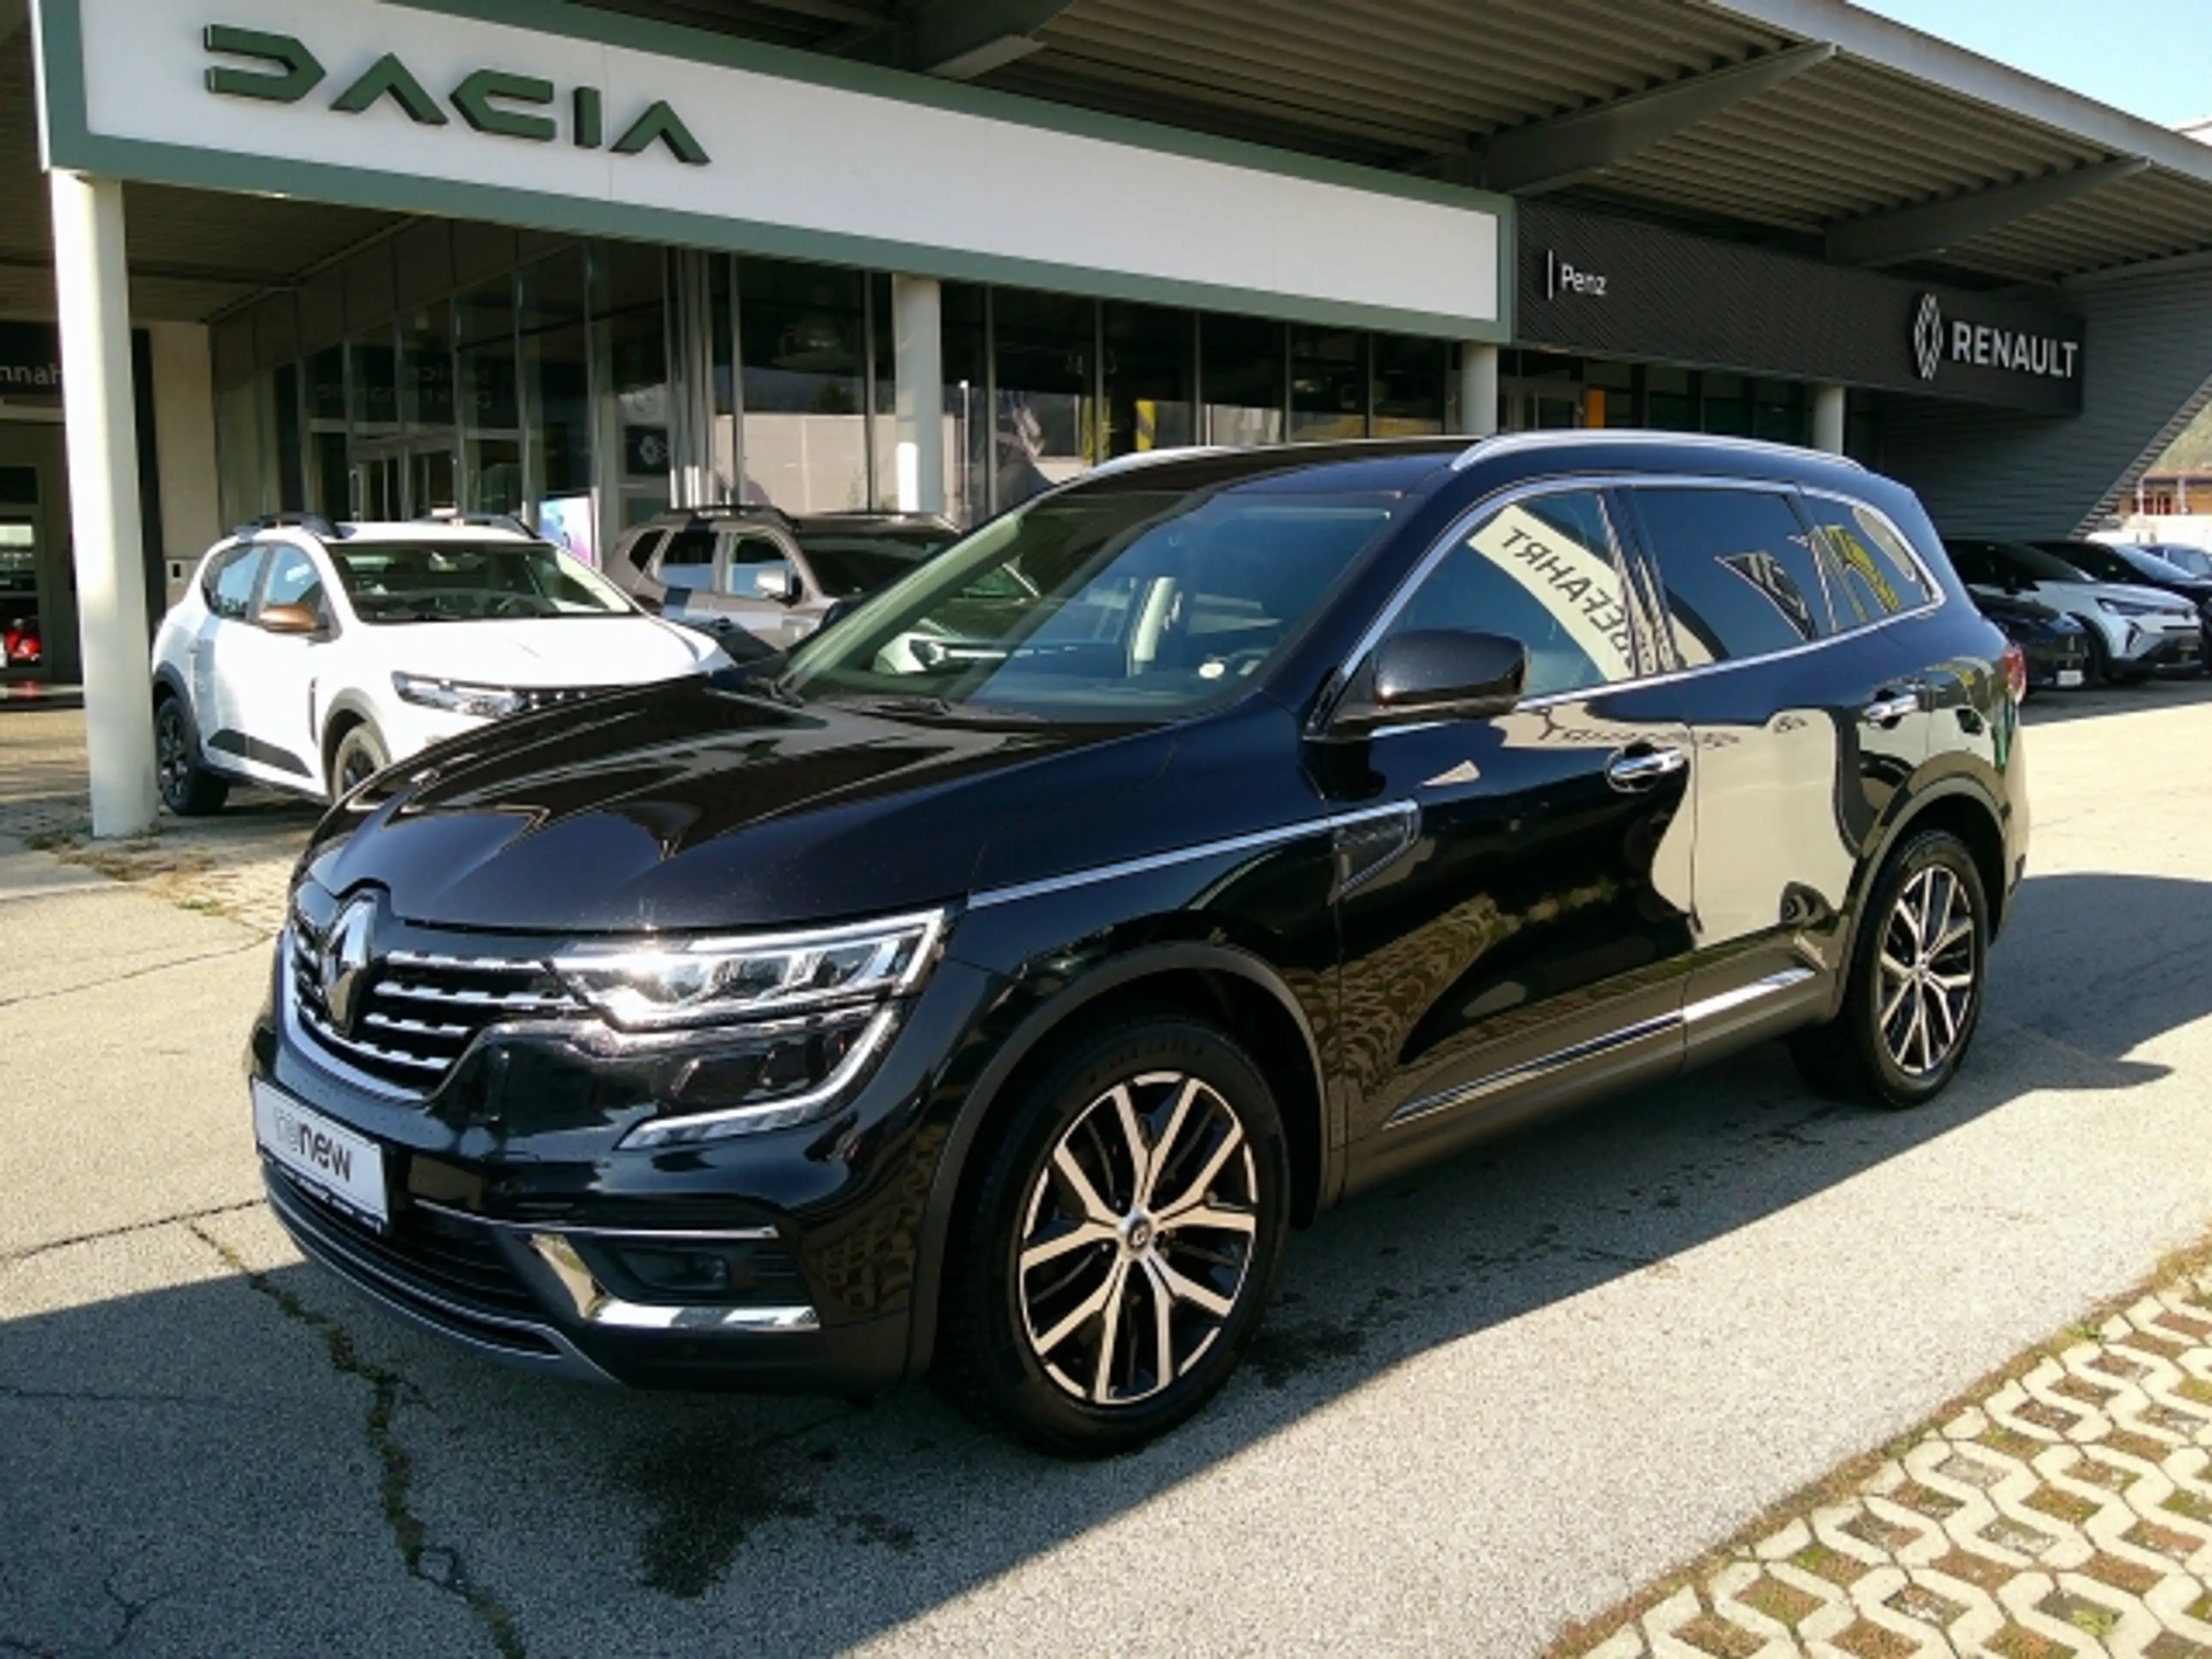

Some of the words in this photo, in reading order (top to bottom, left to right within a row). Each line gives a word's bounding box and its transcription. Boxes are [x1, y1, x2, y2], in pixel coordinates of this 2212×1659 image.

[203, 24, 711, 165] DACIA
[1561, 263, 1606, 295] Penz
[1952, 321, 2078, 378] RENAULT
